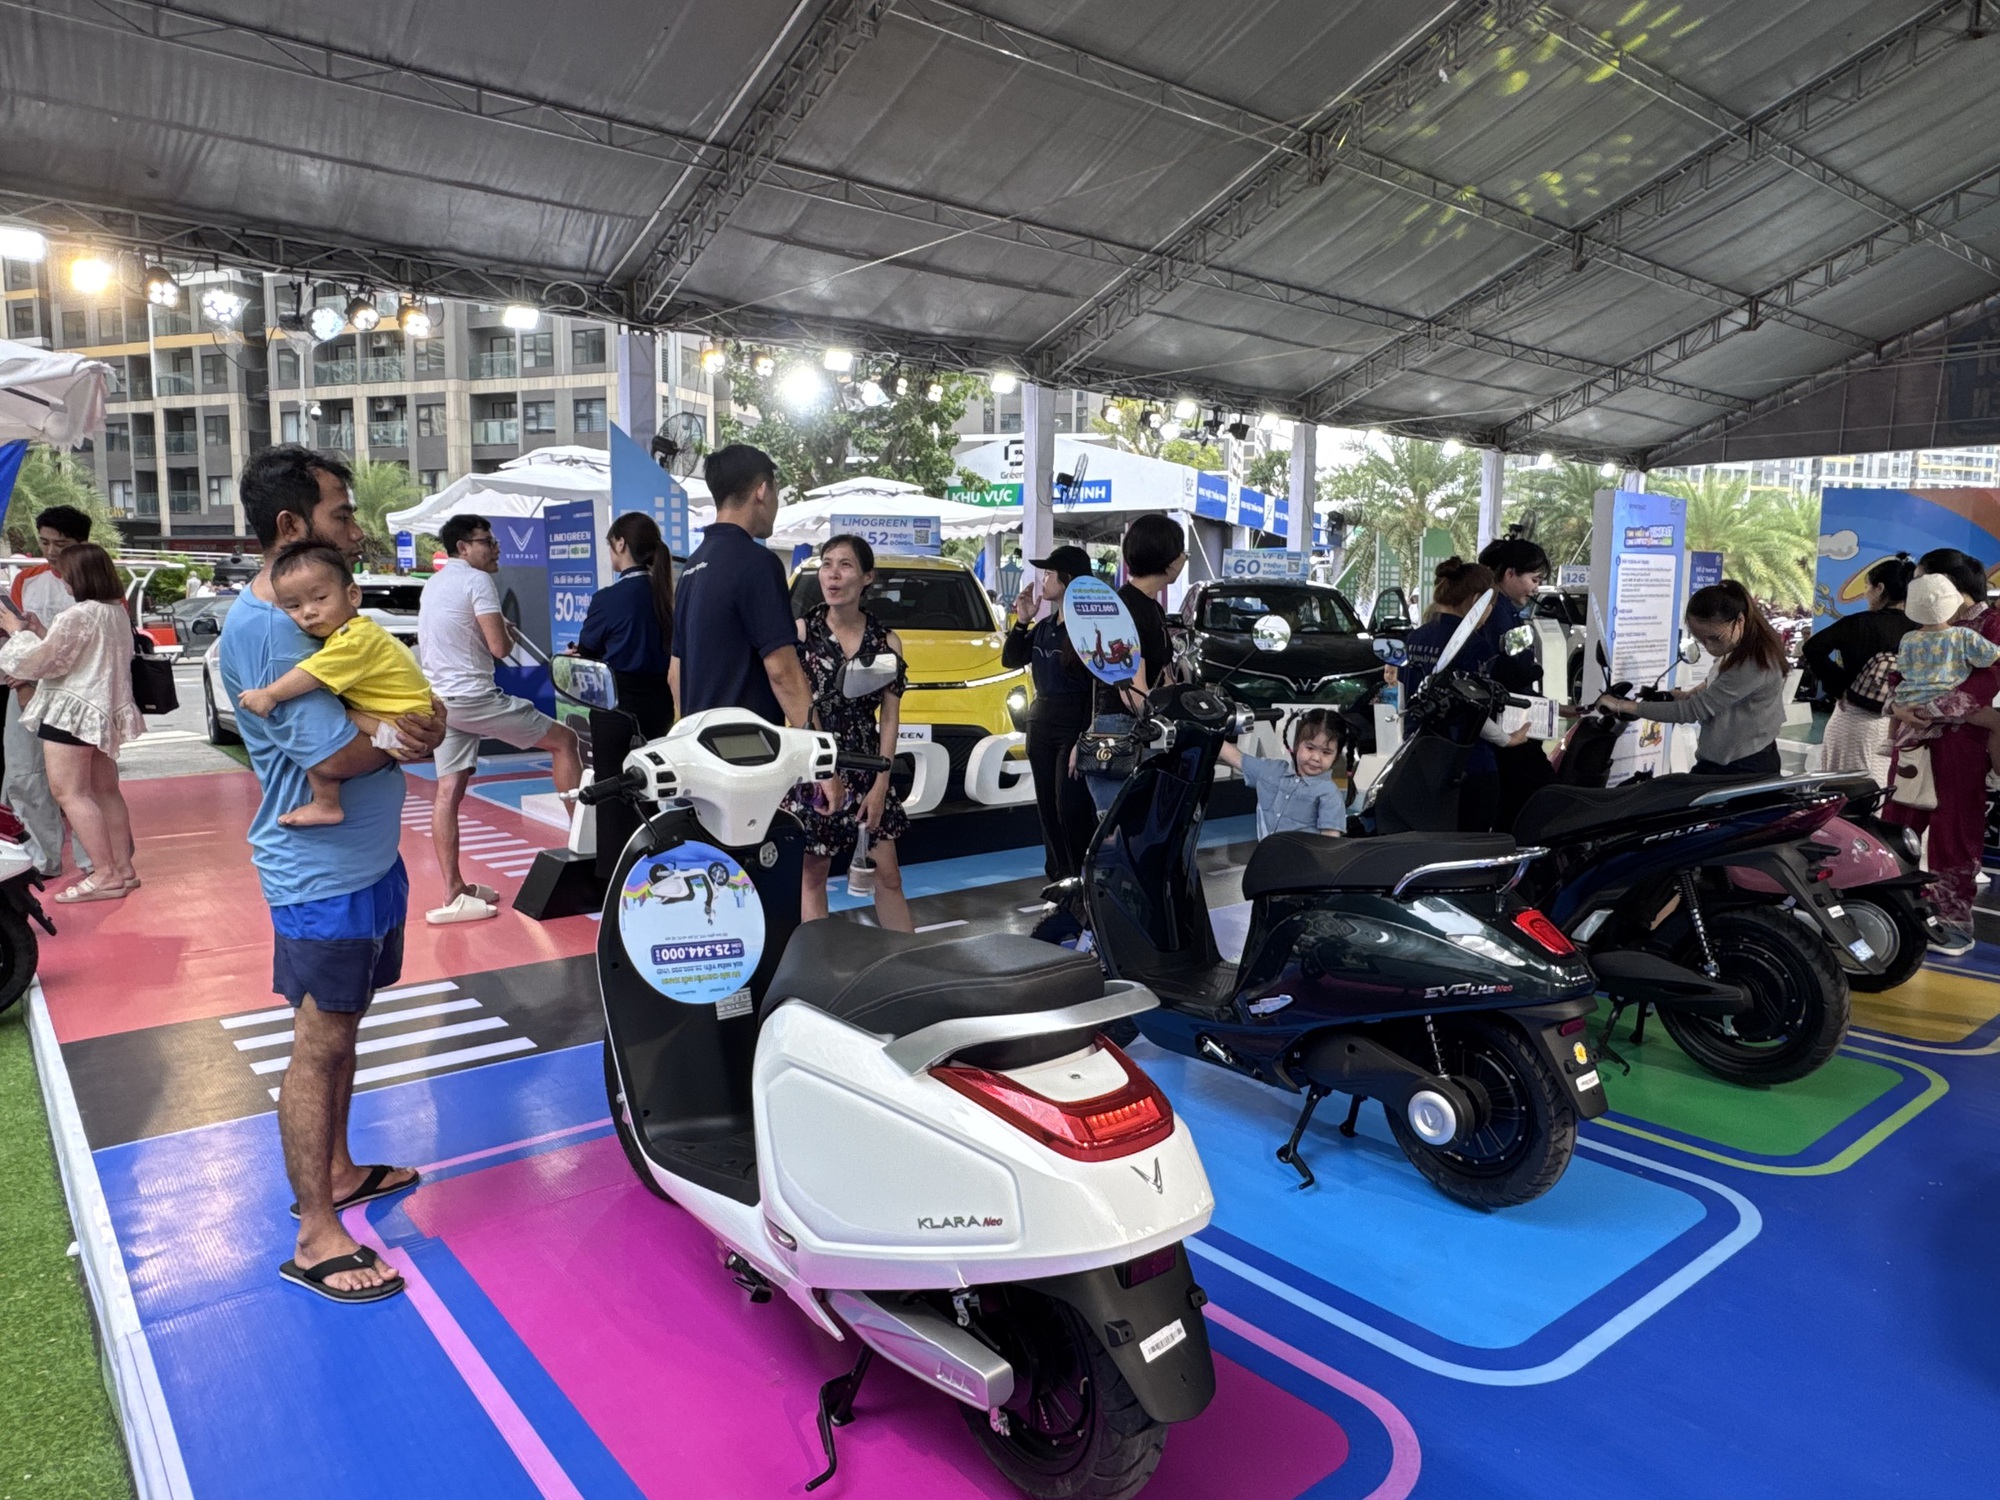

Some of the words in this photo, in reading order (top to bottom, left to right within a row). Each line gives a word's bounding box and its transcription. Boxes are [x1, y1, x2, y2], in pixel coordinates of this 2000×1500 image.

[952, 491, 980, 504] KHU
[983, 488, 1013, 506] VỰC
[842, 518, 908, 528] LIMOGREEN
[868, 532, 888, 546] 52
[1234, 559, 1260, 574] 60
[1566, 572, 1586, 584] 126
[554, 592, 574, 622] 50
[661, 944, 731, 960] 25.344.000
[918, 1215, 981, 1229] KLARA
[982, 1216, 1004, 1228] Neo
